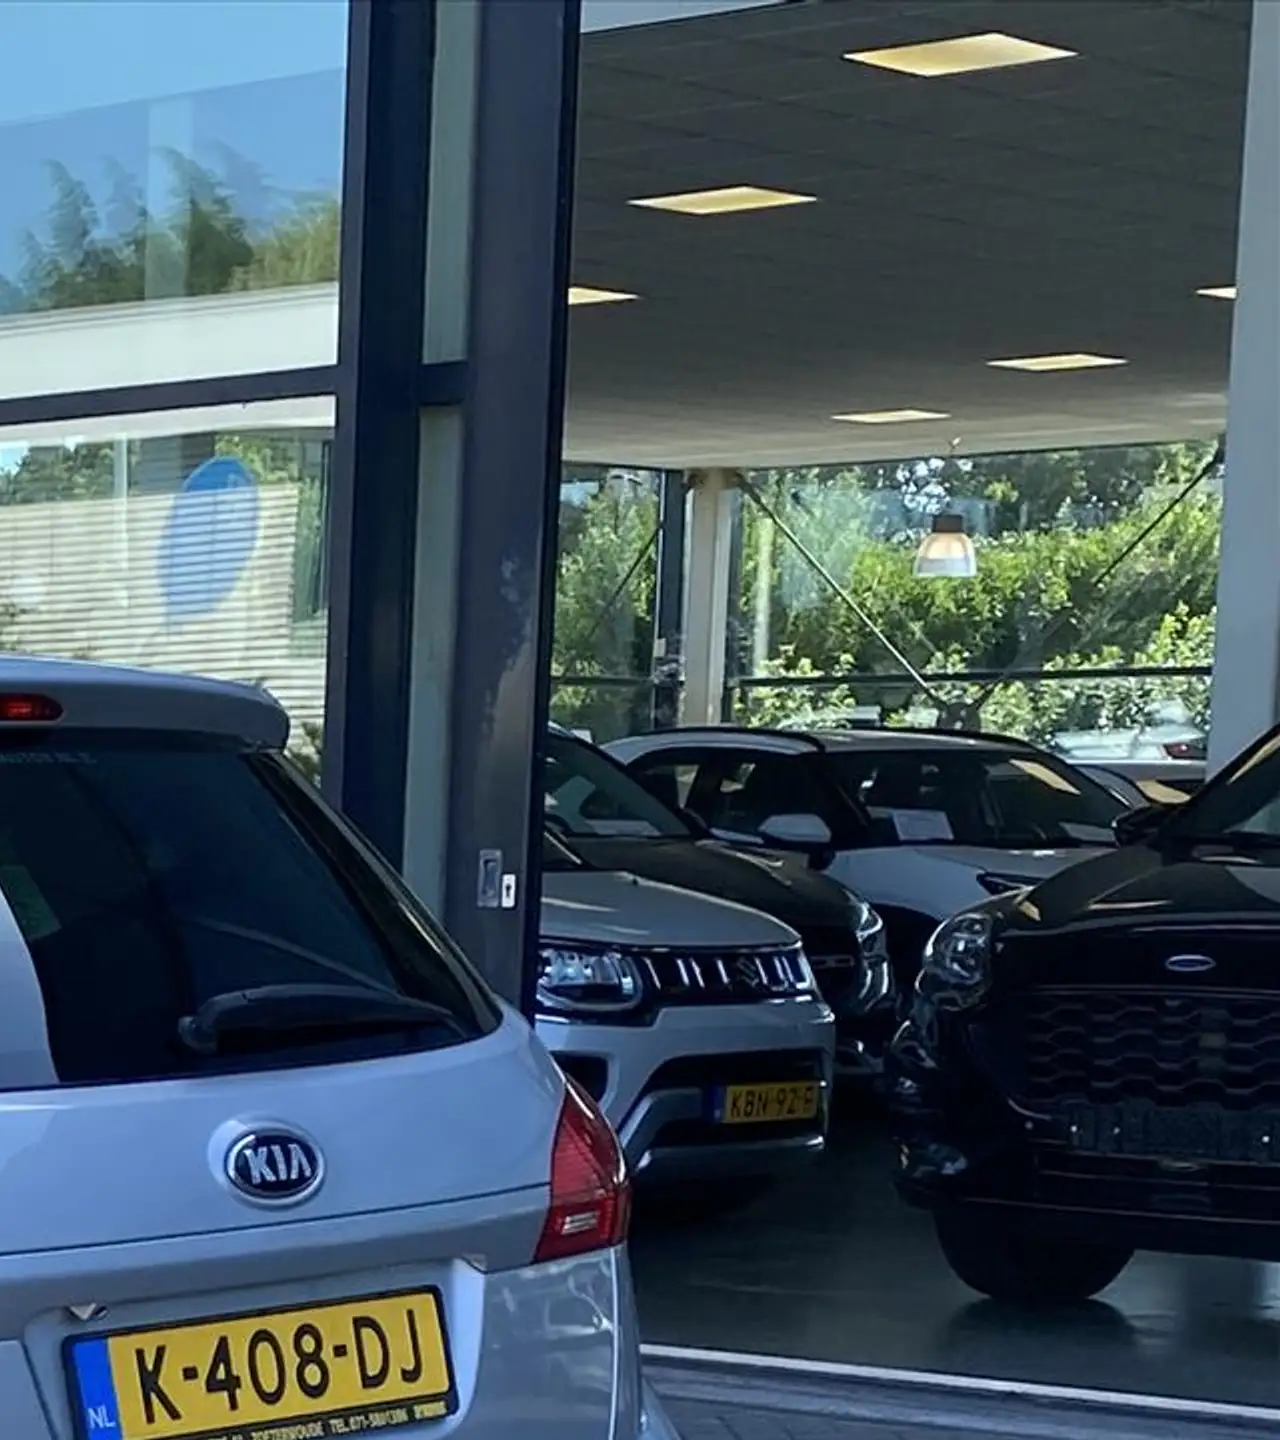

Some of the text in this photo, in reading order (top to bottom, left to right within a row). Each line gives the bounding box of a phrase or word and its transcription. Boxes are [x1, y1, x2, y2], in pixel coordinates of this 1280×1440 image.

[243, 1143, 312, 1184] KIA
[135, 1309, 423, 1425] K-408-DJ
[88, 1405, 116, 1429] NL
